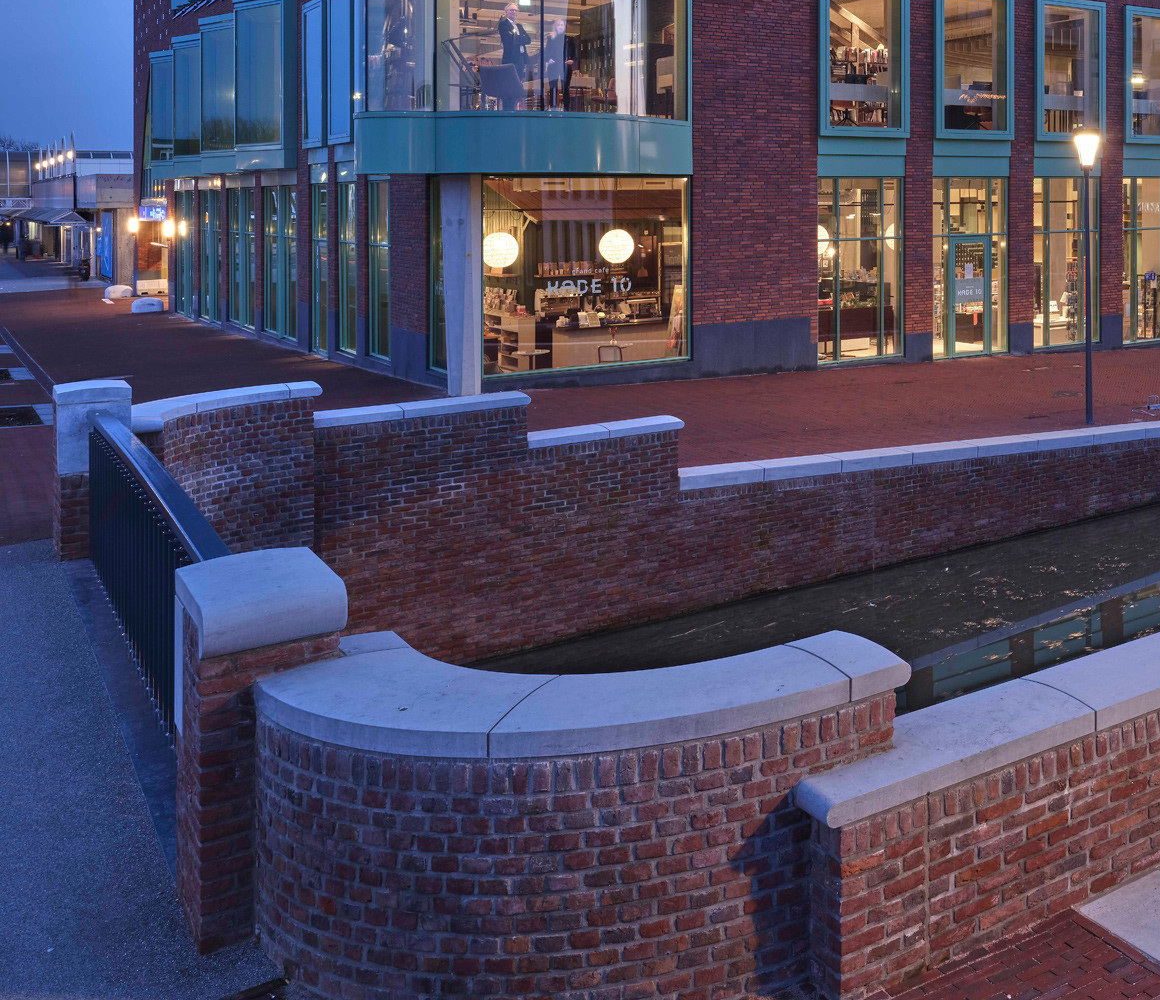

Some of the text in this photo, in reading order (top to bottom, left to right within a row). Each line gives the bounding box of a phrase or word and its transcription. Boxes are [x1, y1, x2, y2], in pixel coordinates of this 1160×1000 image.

[571, 268, 592, 276] grand
[547, 277, 632, 296] KADE 10
